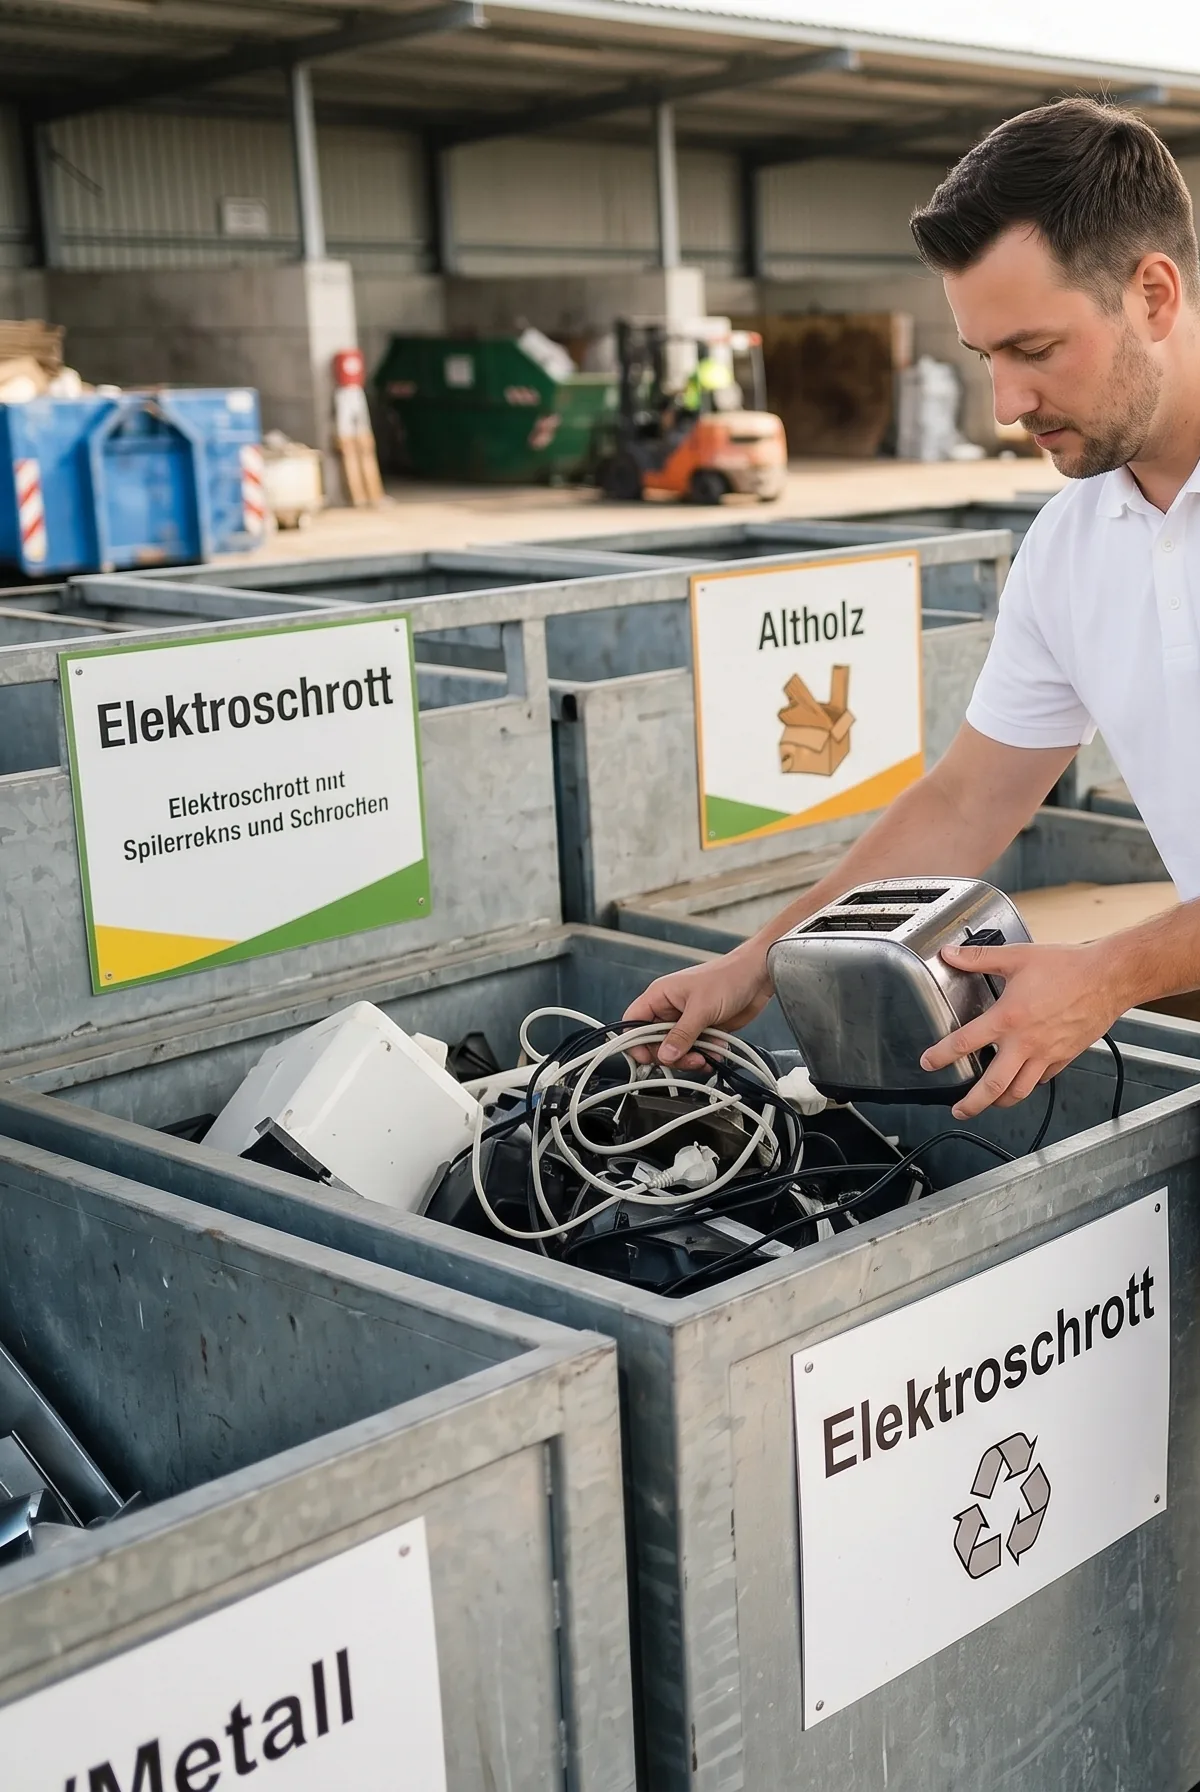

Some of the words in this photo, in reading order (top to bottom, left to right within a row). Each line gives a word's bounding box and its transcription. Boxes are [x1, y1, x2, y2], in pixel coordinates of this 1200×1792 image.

[758, 600, 864, 651] Altholz
[97, 666, 394, 749] Elektroschrott
[168, 775, 311, 819] Elektroschrott
[123, 824, 242, 864] Spilerrekns
[247, 811, 284, 838] und
[823, 1265, 1155, 1479] Elektroschrott
